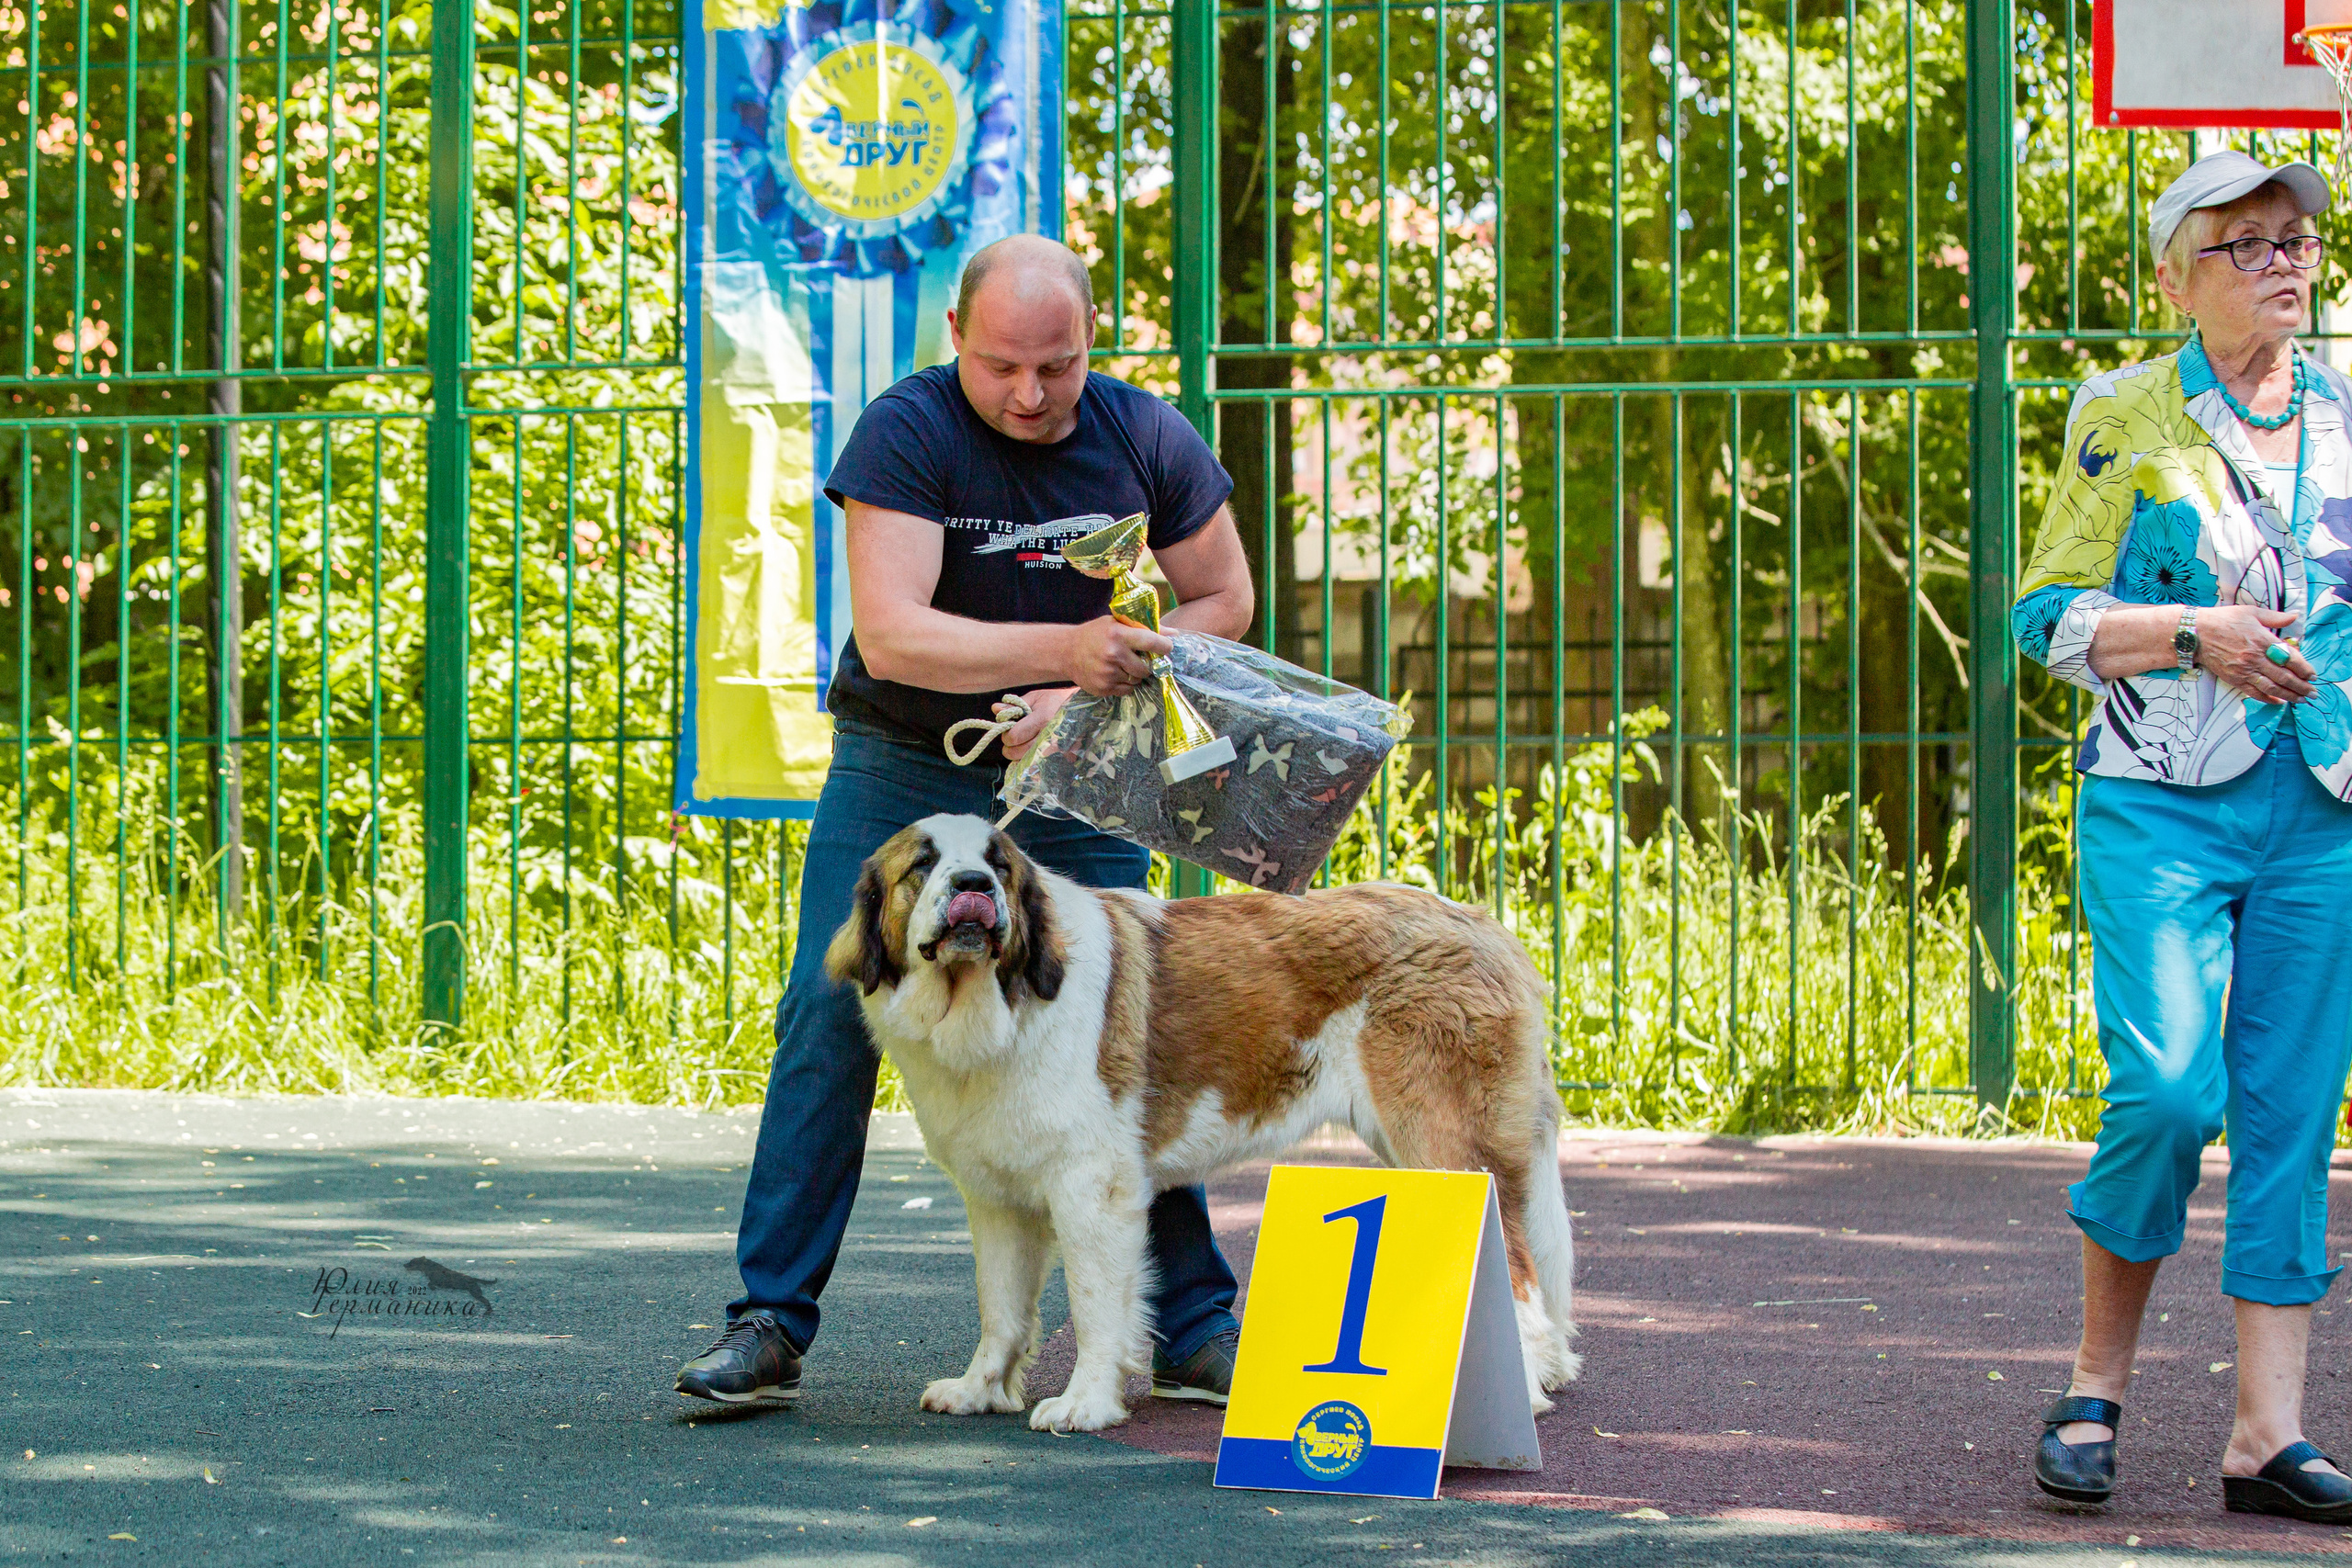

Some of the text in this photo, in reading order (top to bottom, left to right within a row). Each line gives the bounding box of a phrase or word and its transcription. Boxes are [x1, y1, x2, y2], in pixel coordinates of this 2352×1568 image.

[839, 140, 930, 167] ДРУГ
[1024, 560, 1063, 570] HUISION
[1302, 1194, 1388, 1376] 1
[1308, 1441, 1358, 1459] ДРУГ
